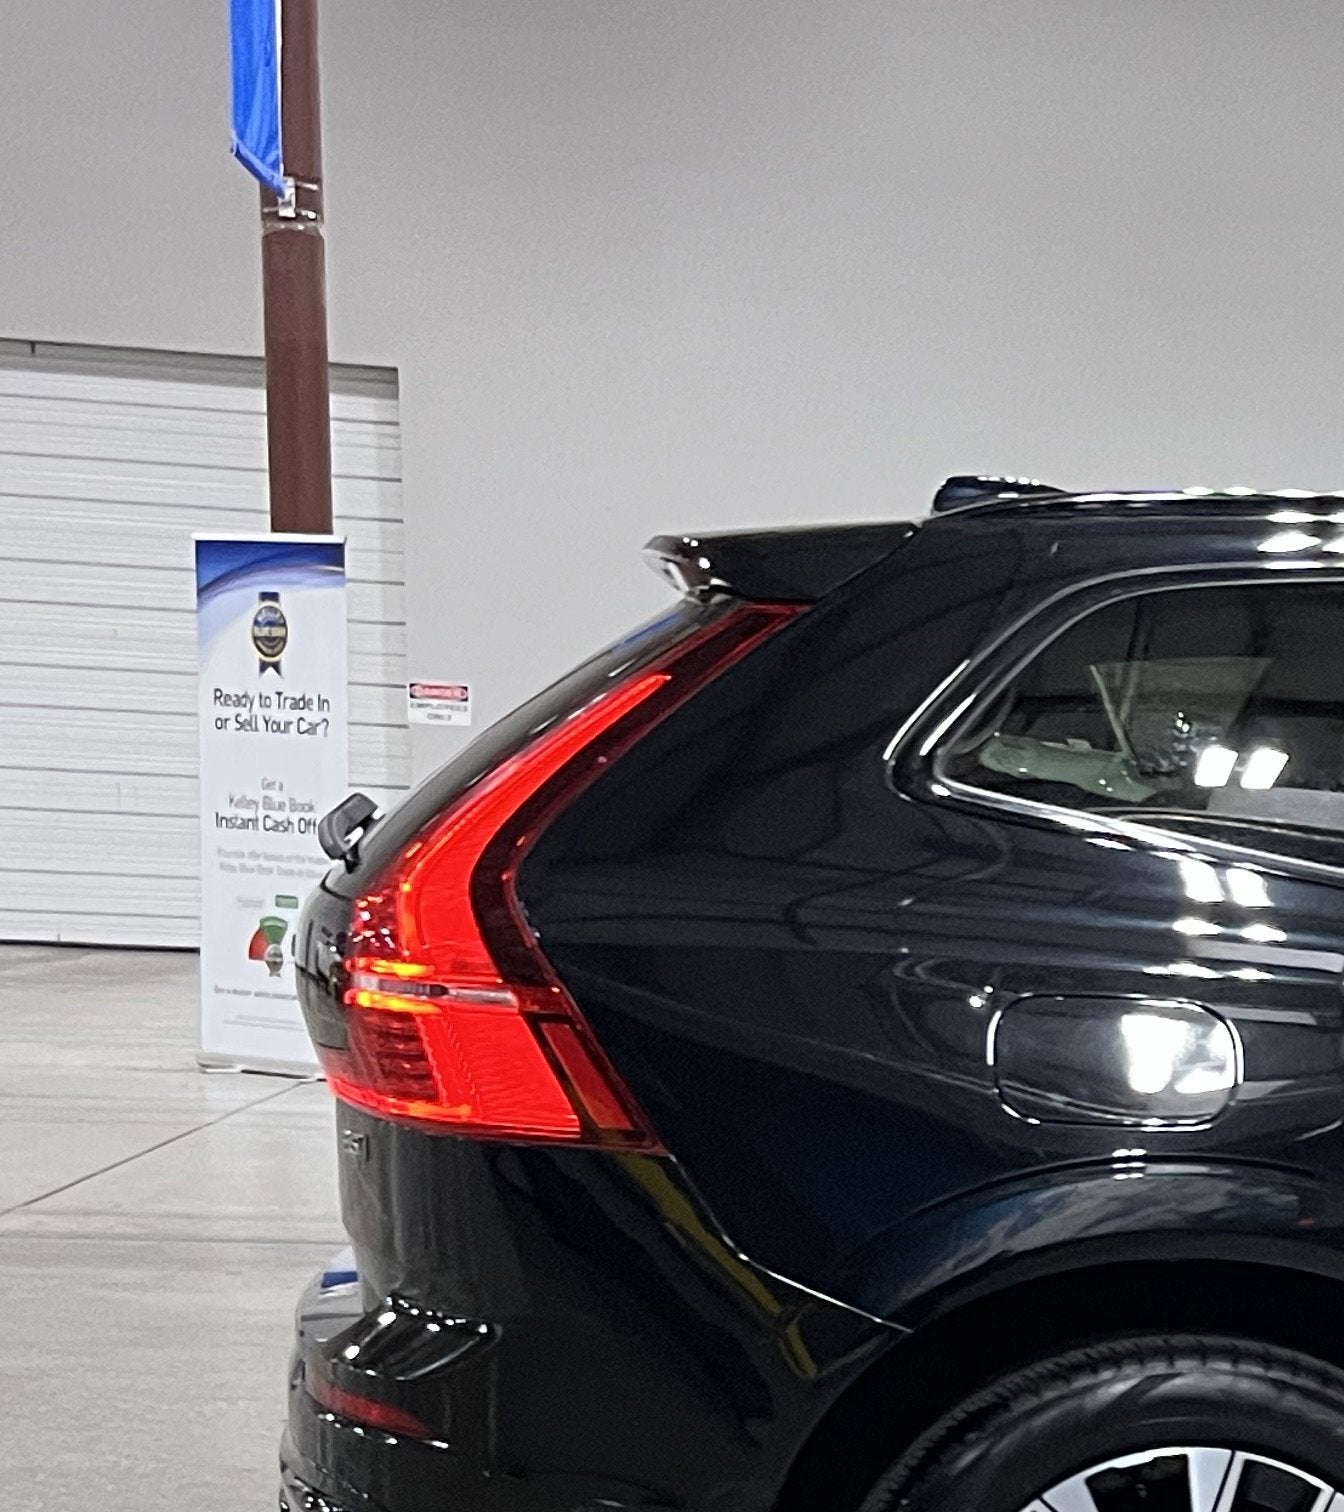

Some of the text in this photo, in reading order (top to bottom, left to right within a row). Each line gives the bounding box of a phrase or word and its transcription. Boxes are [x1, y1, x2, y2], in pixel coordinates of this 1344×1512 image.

[213, 687, 330, 713] Ready to Trade In
[214, 712, 330, 738] or Sell Your Car?
[215, 811, 260, 831] Instant
[262, 814, 295, 833] Cash
